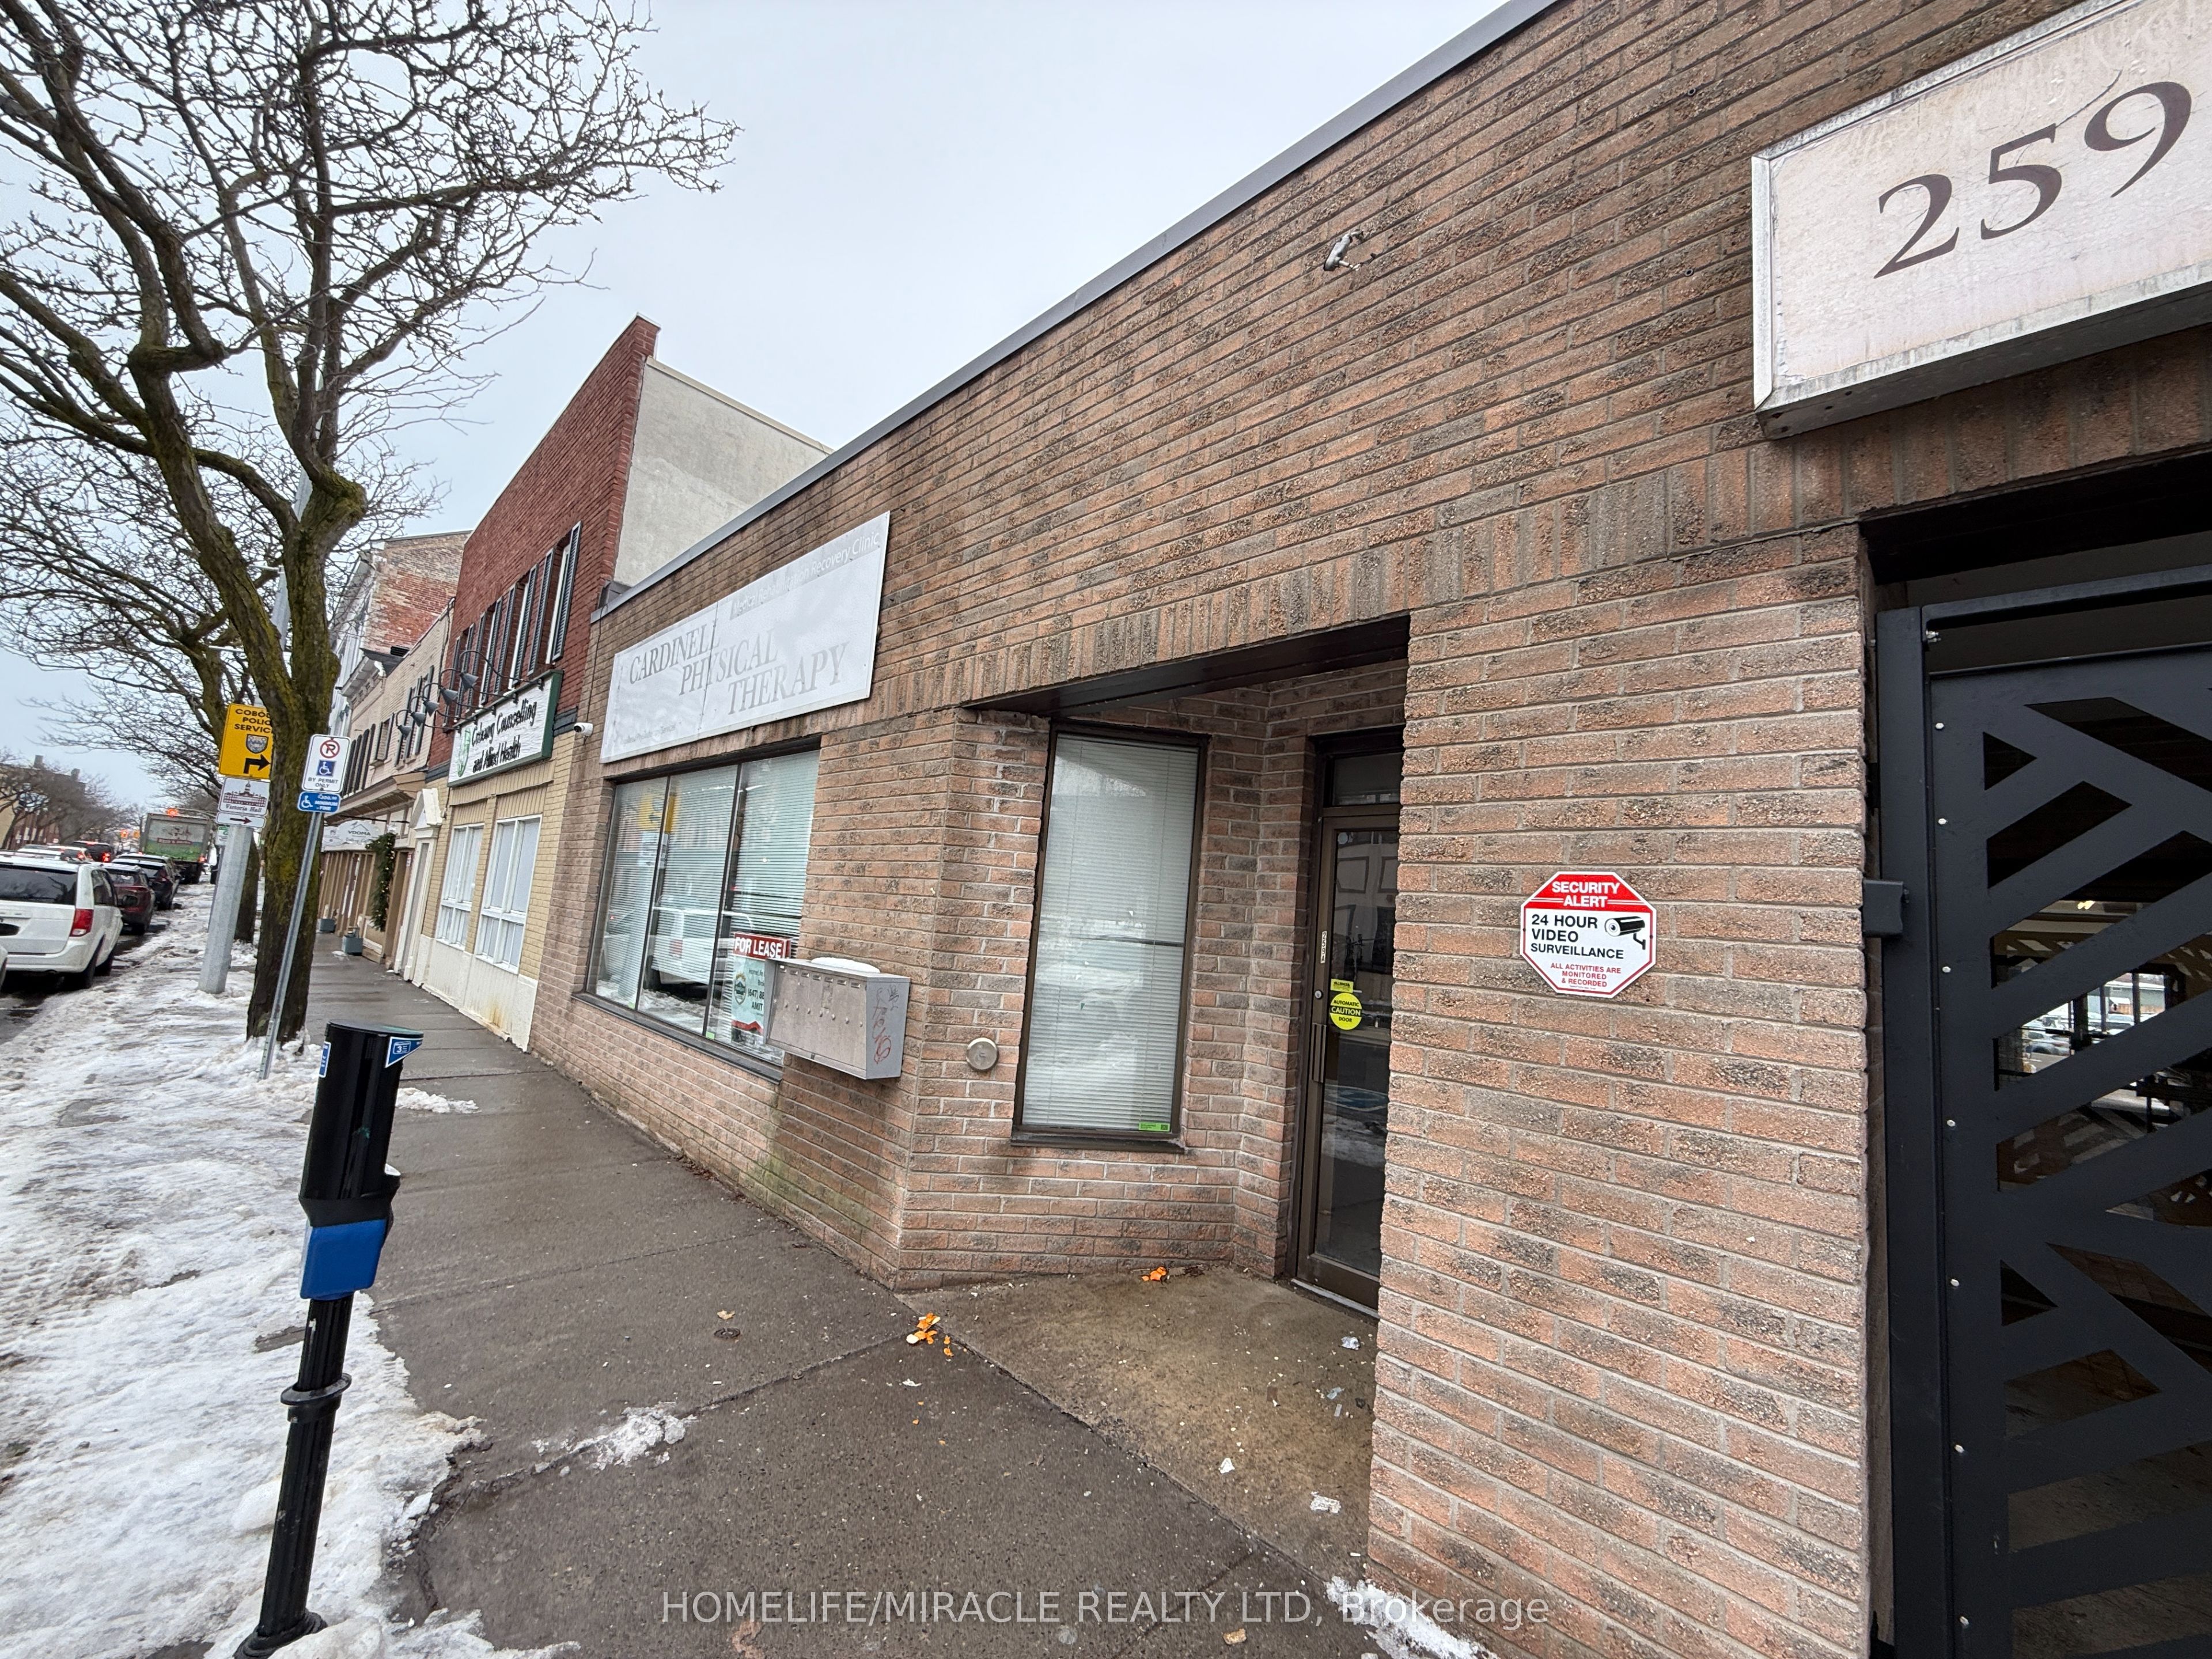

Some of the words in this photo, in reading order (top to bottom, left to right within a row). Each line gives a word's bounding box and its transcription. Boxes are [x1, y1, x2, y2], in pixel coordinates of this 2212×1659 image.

[1873, 81, 2192, 279] 259
[811, 546, 851, 575] Recovery
[852, 532, 880, 555] Clinic
[679, 628, 778, 696] PHYSICAL
[728, 641, 850, 715] THERAPY
[243, 717, 271, 725] POLIC
[234, 724, 271, 733] SERVIC
[1552, 881, 1620, 894] SECURITY
[1563, 895, 1608, 908] ALERT
[1531, 914, 1549, 926] 24
[1554, 915, 1598, 929] HOUR
[1531, 928, 1579, 942] VIDEO
[734, 937, 752, 953] FOR
[753, 940, 782, 959] LEASE
[1531, 943, 1624, 959] SURVEILLANCE
[1566, 964, 1604, 972] ACTIVITIES
[1562, 971, 1607, 980] MONITORED
[1568, 978, 1607, 987] RECORDED
[751, 1001, 763, 1012] AMIT
[1331, 1006, 1361, 1016] CAUTION
